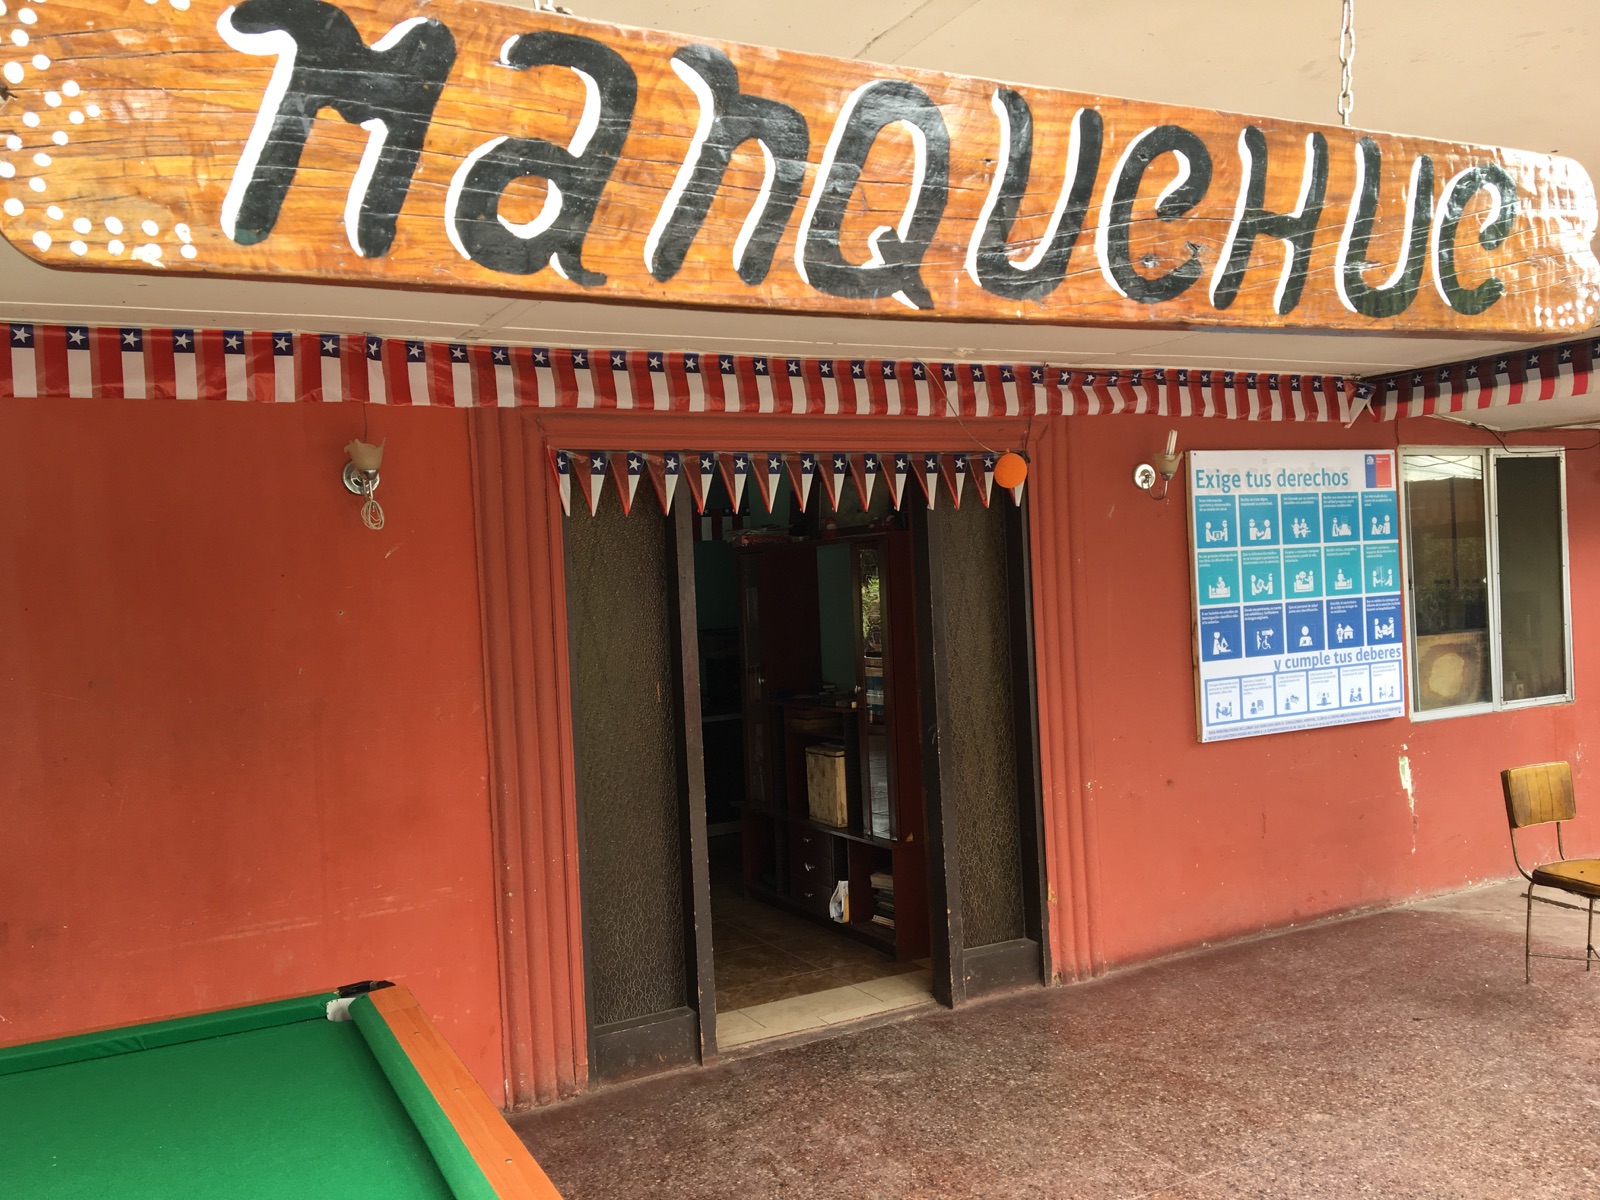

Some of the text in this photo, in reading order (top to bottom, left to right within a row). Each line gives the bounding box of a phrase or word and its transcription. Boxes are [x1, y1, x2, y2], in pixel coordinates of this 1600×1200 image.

[1195, 467, 1349, 493] Exige tus derechos
[1274, 646, 1402, 672] y cumple tus deberes
